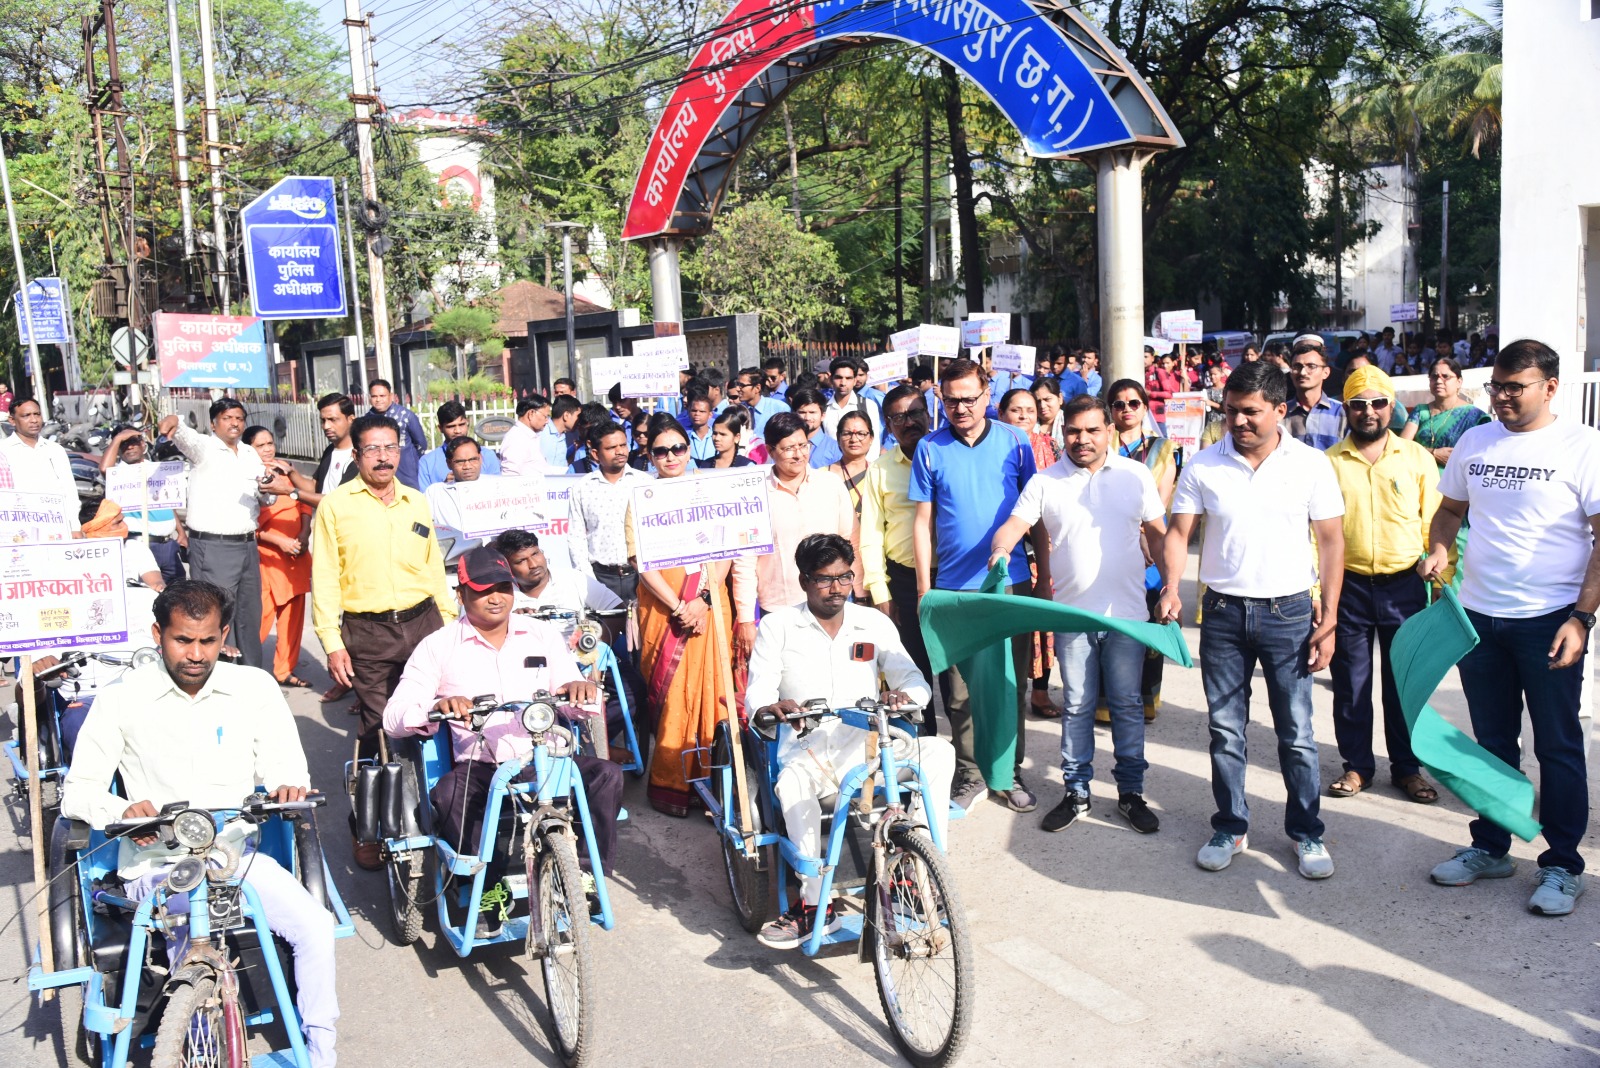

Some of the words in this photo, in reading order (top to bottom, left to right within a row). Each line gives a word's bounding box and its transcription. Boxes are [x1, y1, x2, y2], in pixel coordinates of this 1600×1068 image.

[644, 97, 698, 207] कार्यालय
[701, 17, 758, 104] पुलिस
[268, 242, 320, 258] कार्यालय
[277, 261, 315, 280] पुलिस
[273, 279, 324, 296] अधीक्षक
[179, 317, 243, 336] कार्यालय
[162, 336, 202, 356] पुलिस
[211, 337, 262, 354] अधीक्षक
[177, 359, 216, 373] बिलासपुर
[1468, 463, 1557, 482] SUPERDRY
[1481, 477, 1526, 491] SPORT
[641, 508, 684, 528] मतदाता
[741, 496, 764, 515] रैली
[64, 547, 110, 561] SWEEP
[5, 579, 83, 600] जागरूकता
[82, 572, 113, 594] रैली
